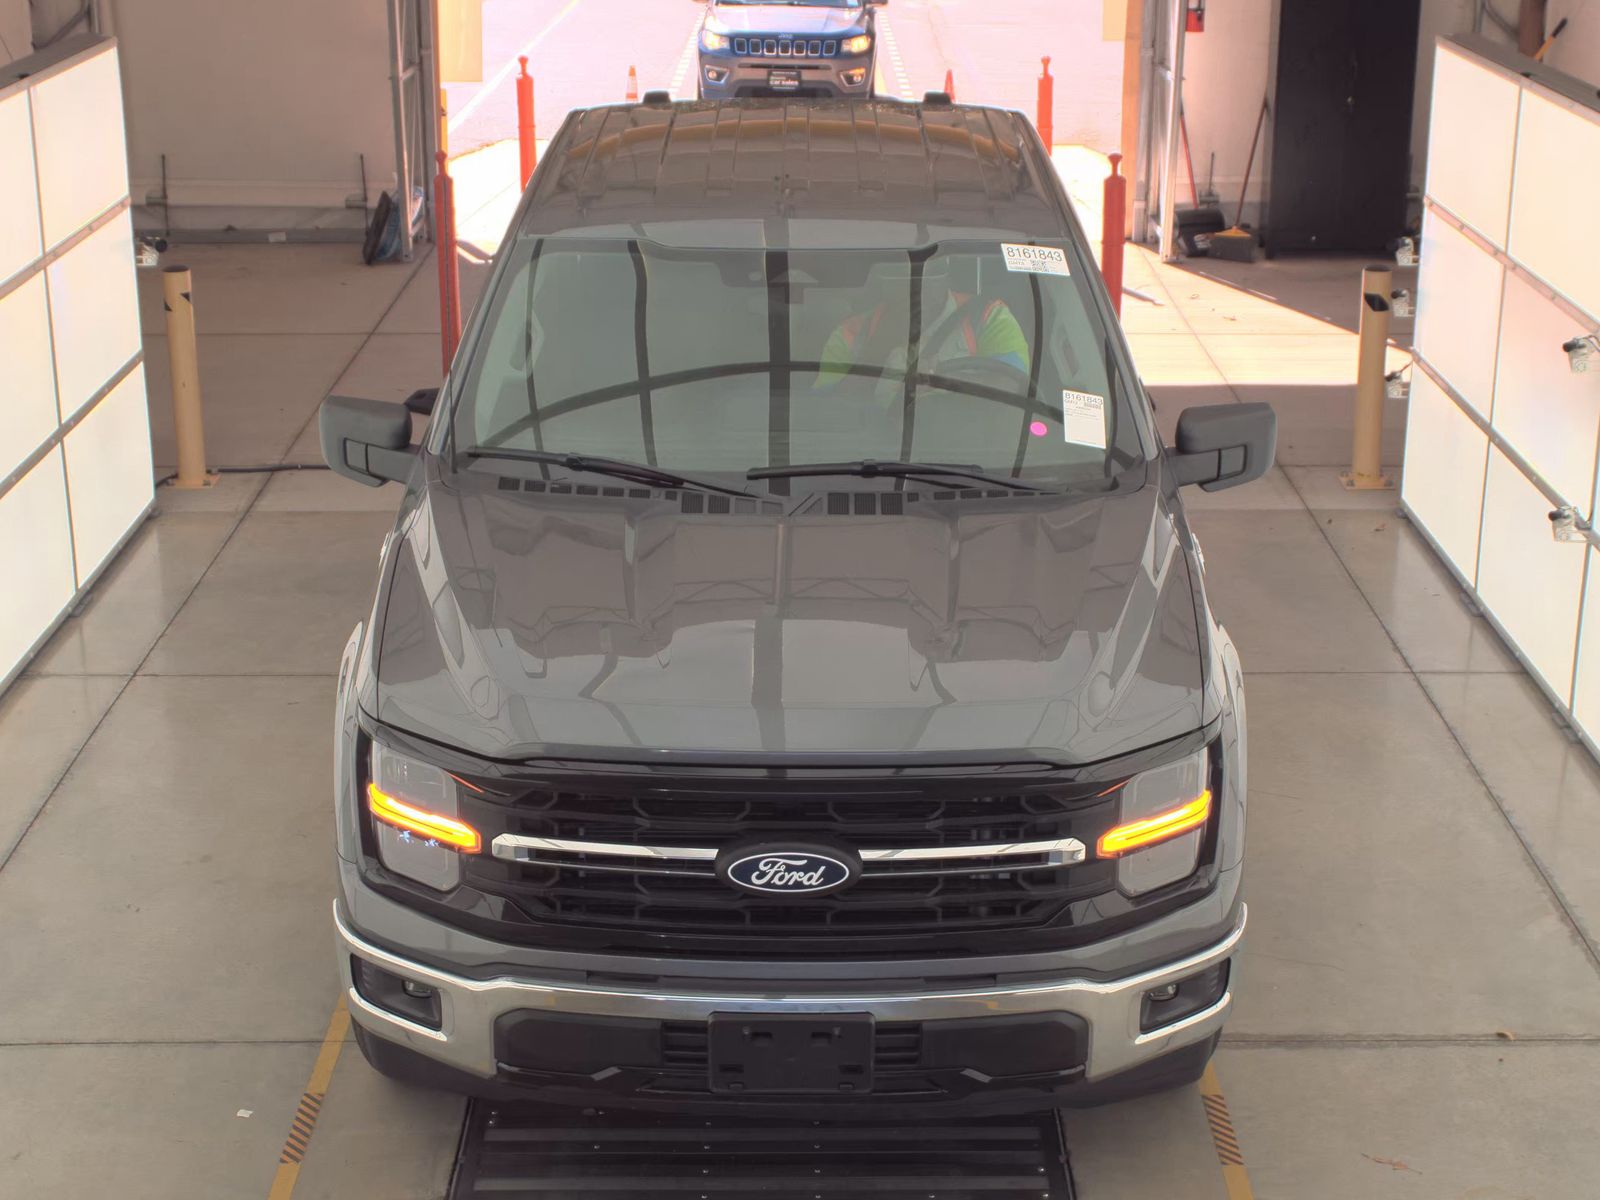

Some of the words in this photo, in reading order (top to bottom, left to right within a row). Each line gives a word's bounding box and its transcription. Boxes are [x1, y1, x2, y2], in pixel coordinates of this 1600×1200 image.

[1006, 247, 1063, 262] 8161843
[1064, 392, 1103, 406] 8161843
[751, 858, 826, 885] Ford
